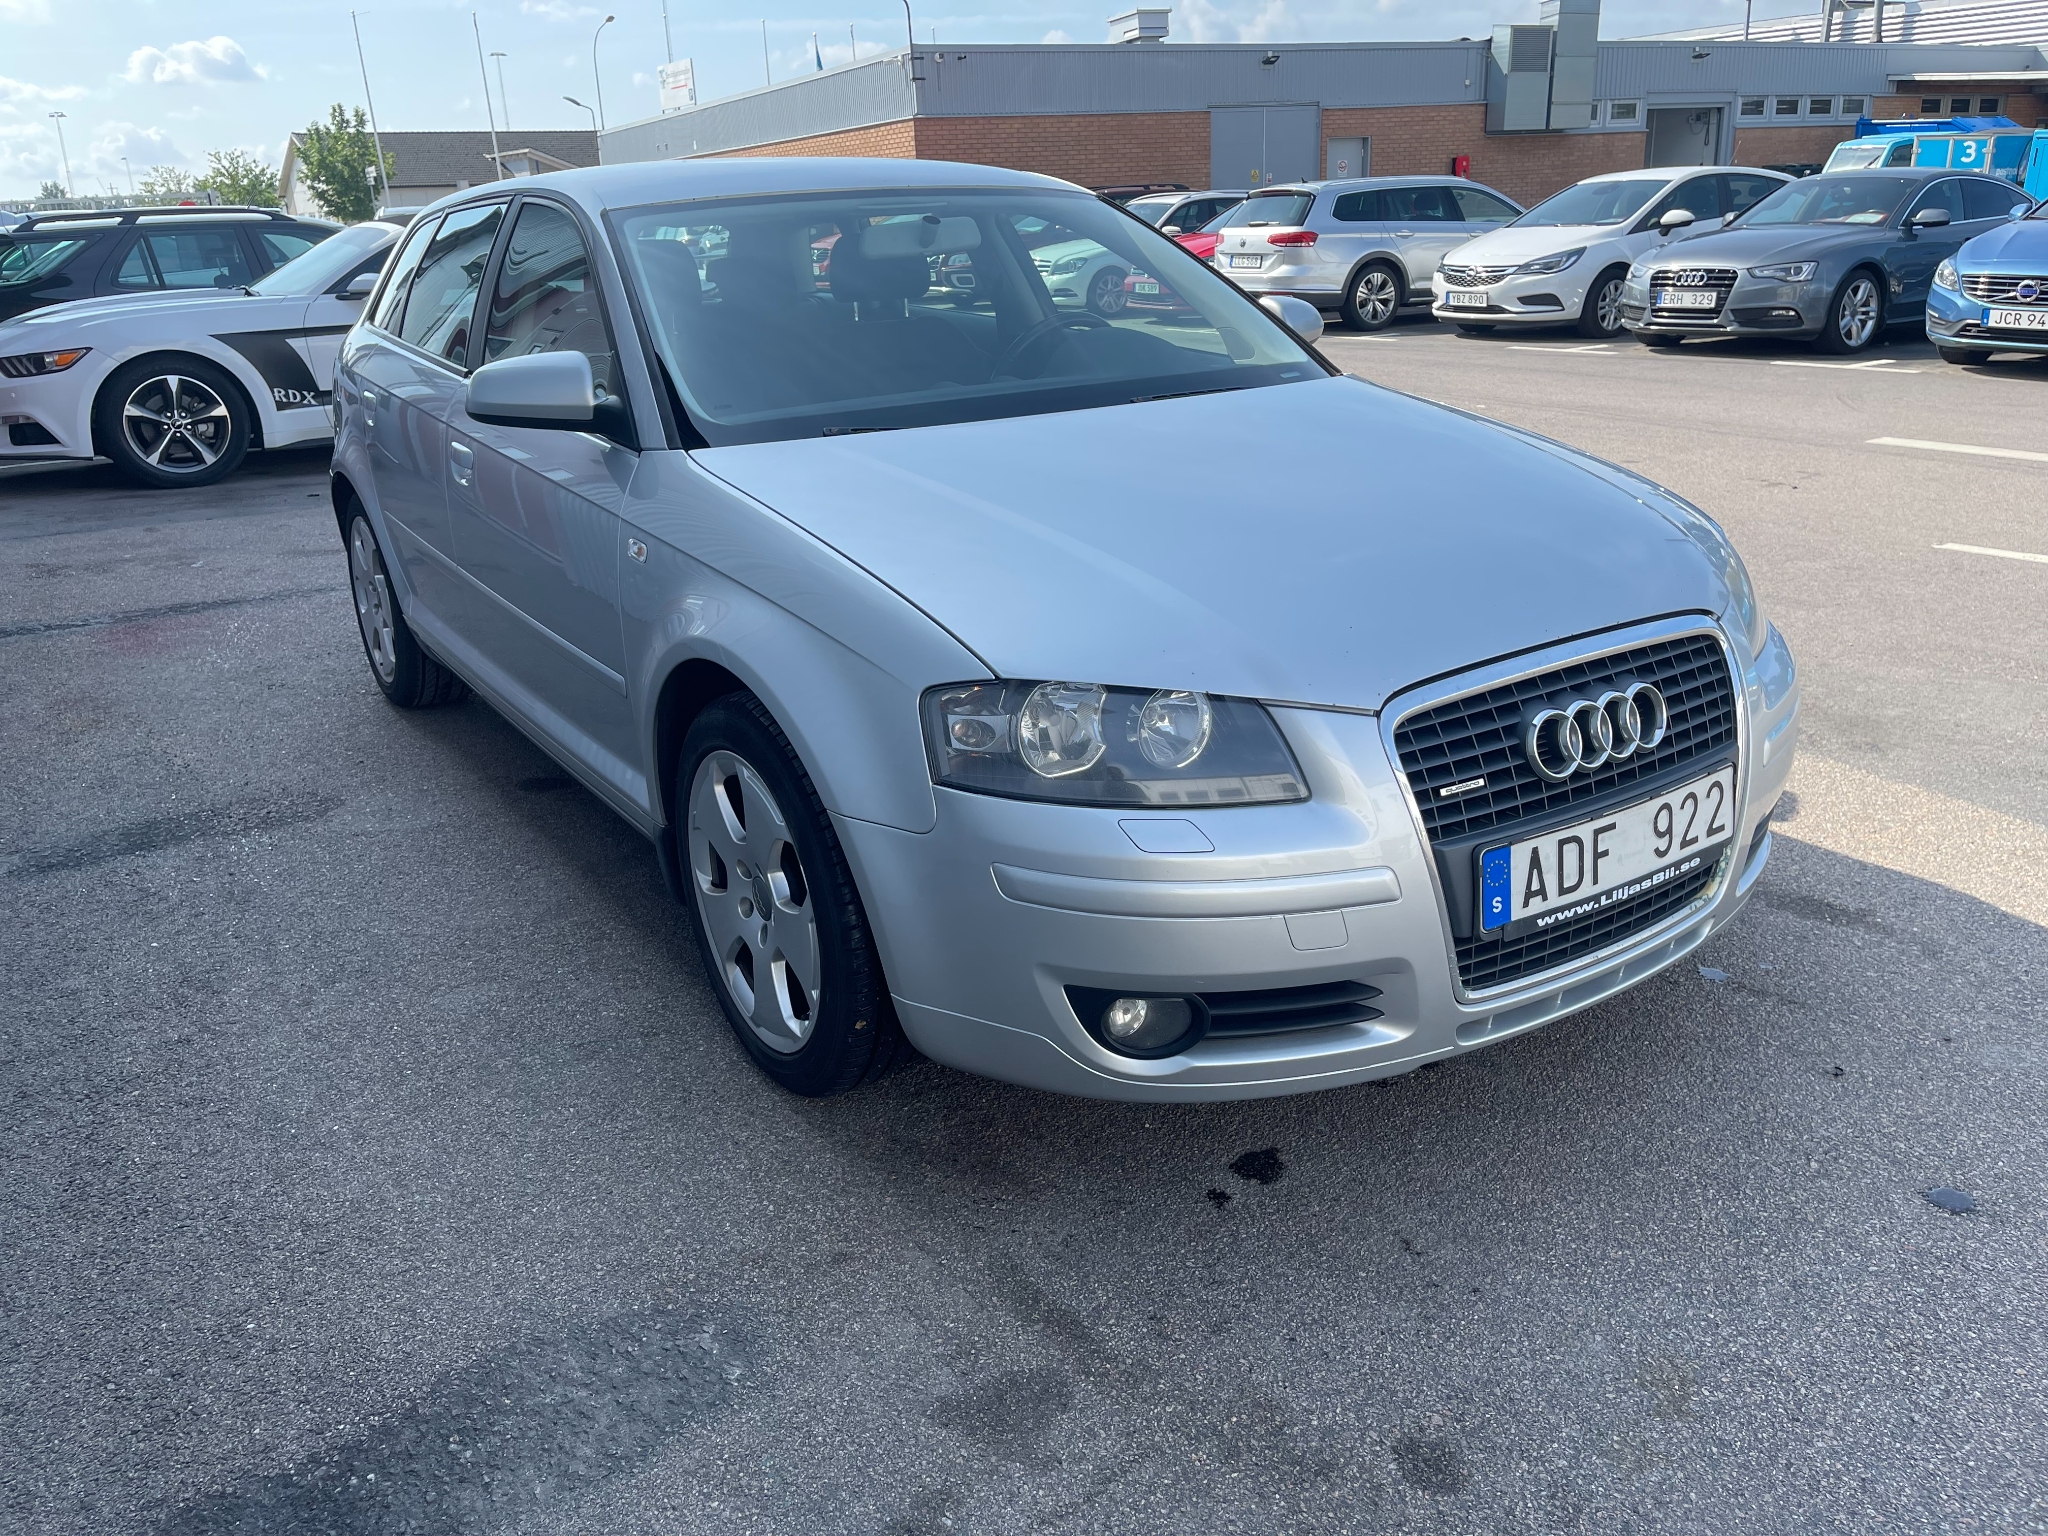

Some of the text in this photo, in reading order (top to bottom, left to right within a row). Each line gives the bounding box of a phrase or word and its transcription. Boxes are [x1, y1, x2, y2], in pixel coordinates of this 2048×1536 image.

[1960, 140, 1977, 163] 3
[1452, 294, 1466, 304] YBZ
[1468, 294, 1484, 305] 890
[1663, 293, 1714, 306] ERH 329
[1994, 311, 2046, 328] JCR 94
[273, 387, 320, 406] RDX
[1445, 780, 1480, 794] quattro
[1522, 780, 1727, 909] ADF 922
[1536, 856, 1701, 928] www.LiljasBil.se
[1492, 896, 1503, 914] S
